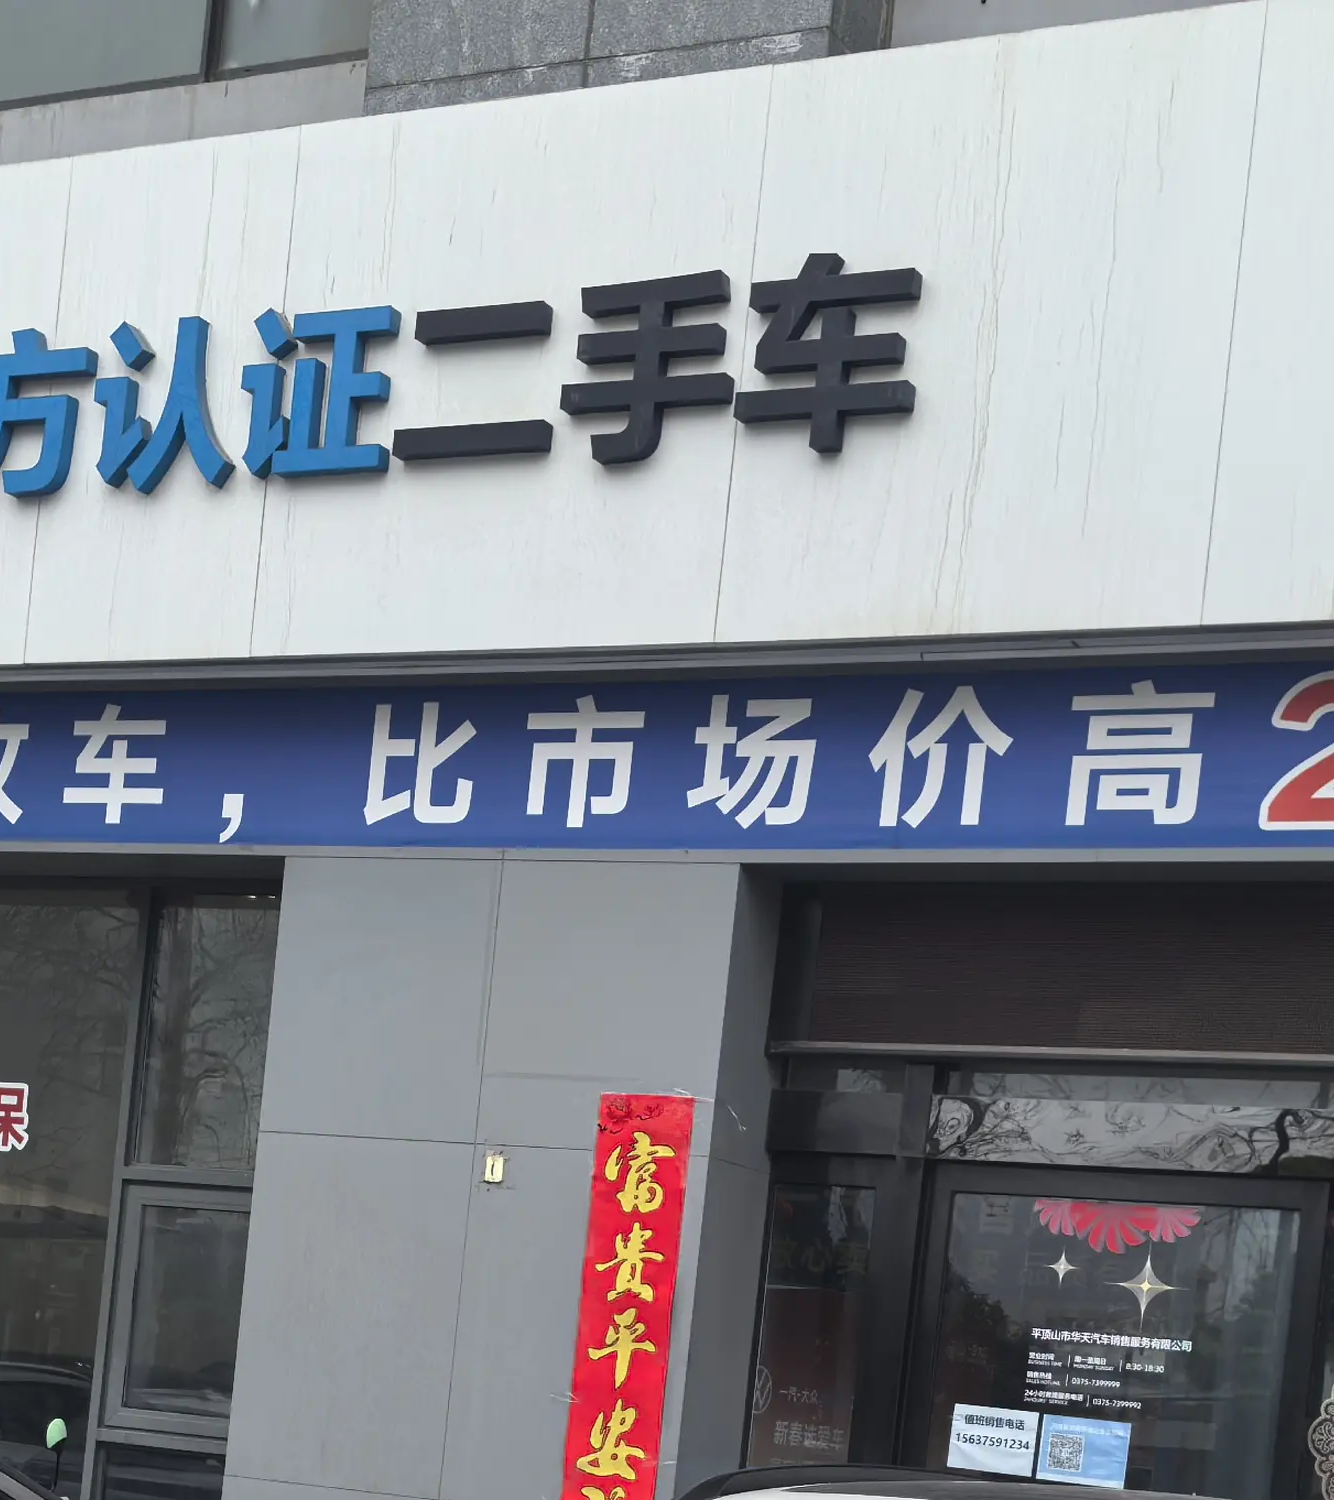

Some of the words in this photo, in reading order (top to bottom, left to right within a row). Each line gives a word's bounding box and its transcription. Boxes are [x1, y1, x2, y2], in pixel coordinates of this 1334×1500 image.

[964, 1413, 1026, 1432] 值班销售电话
[955, 1432, 1030, 1451] 15637591234
